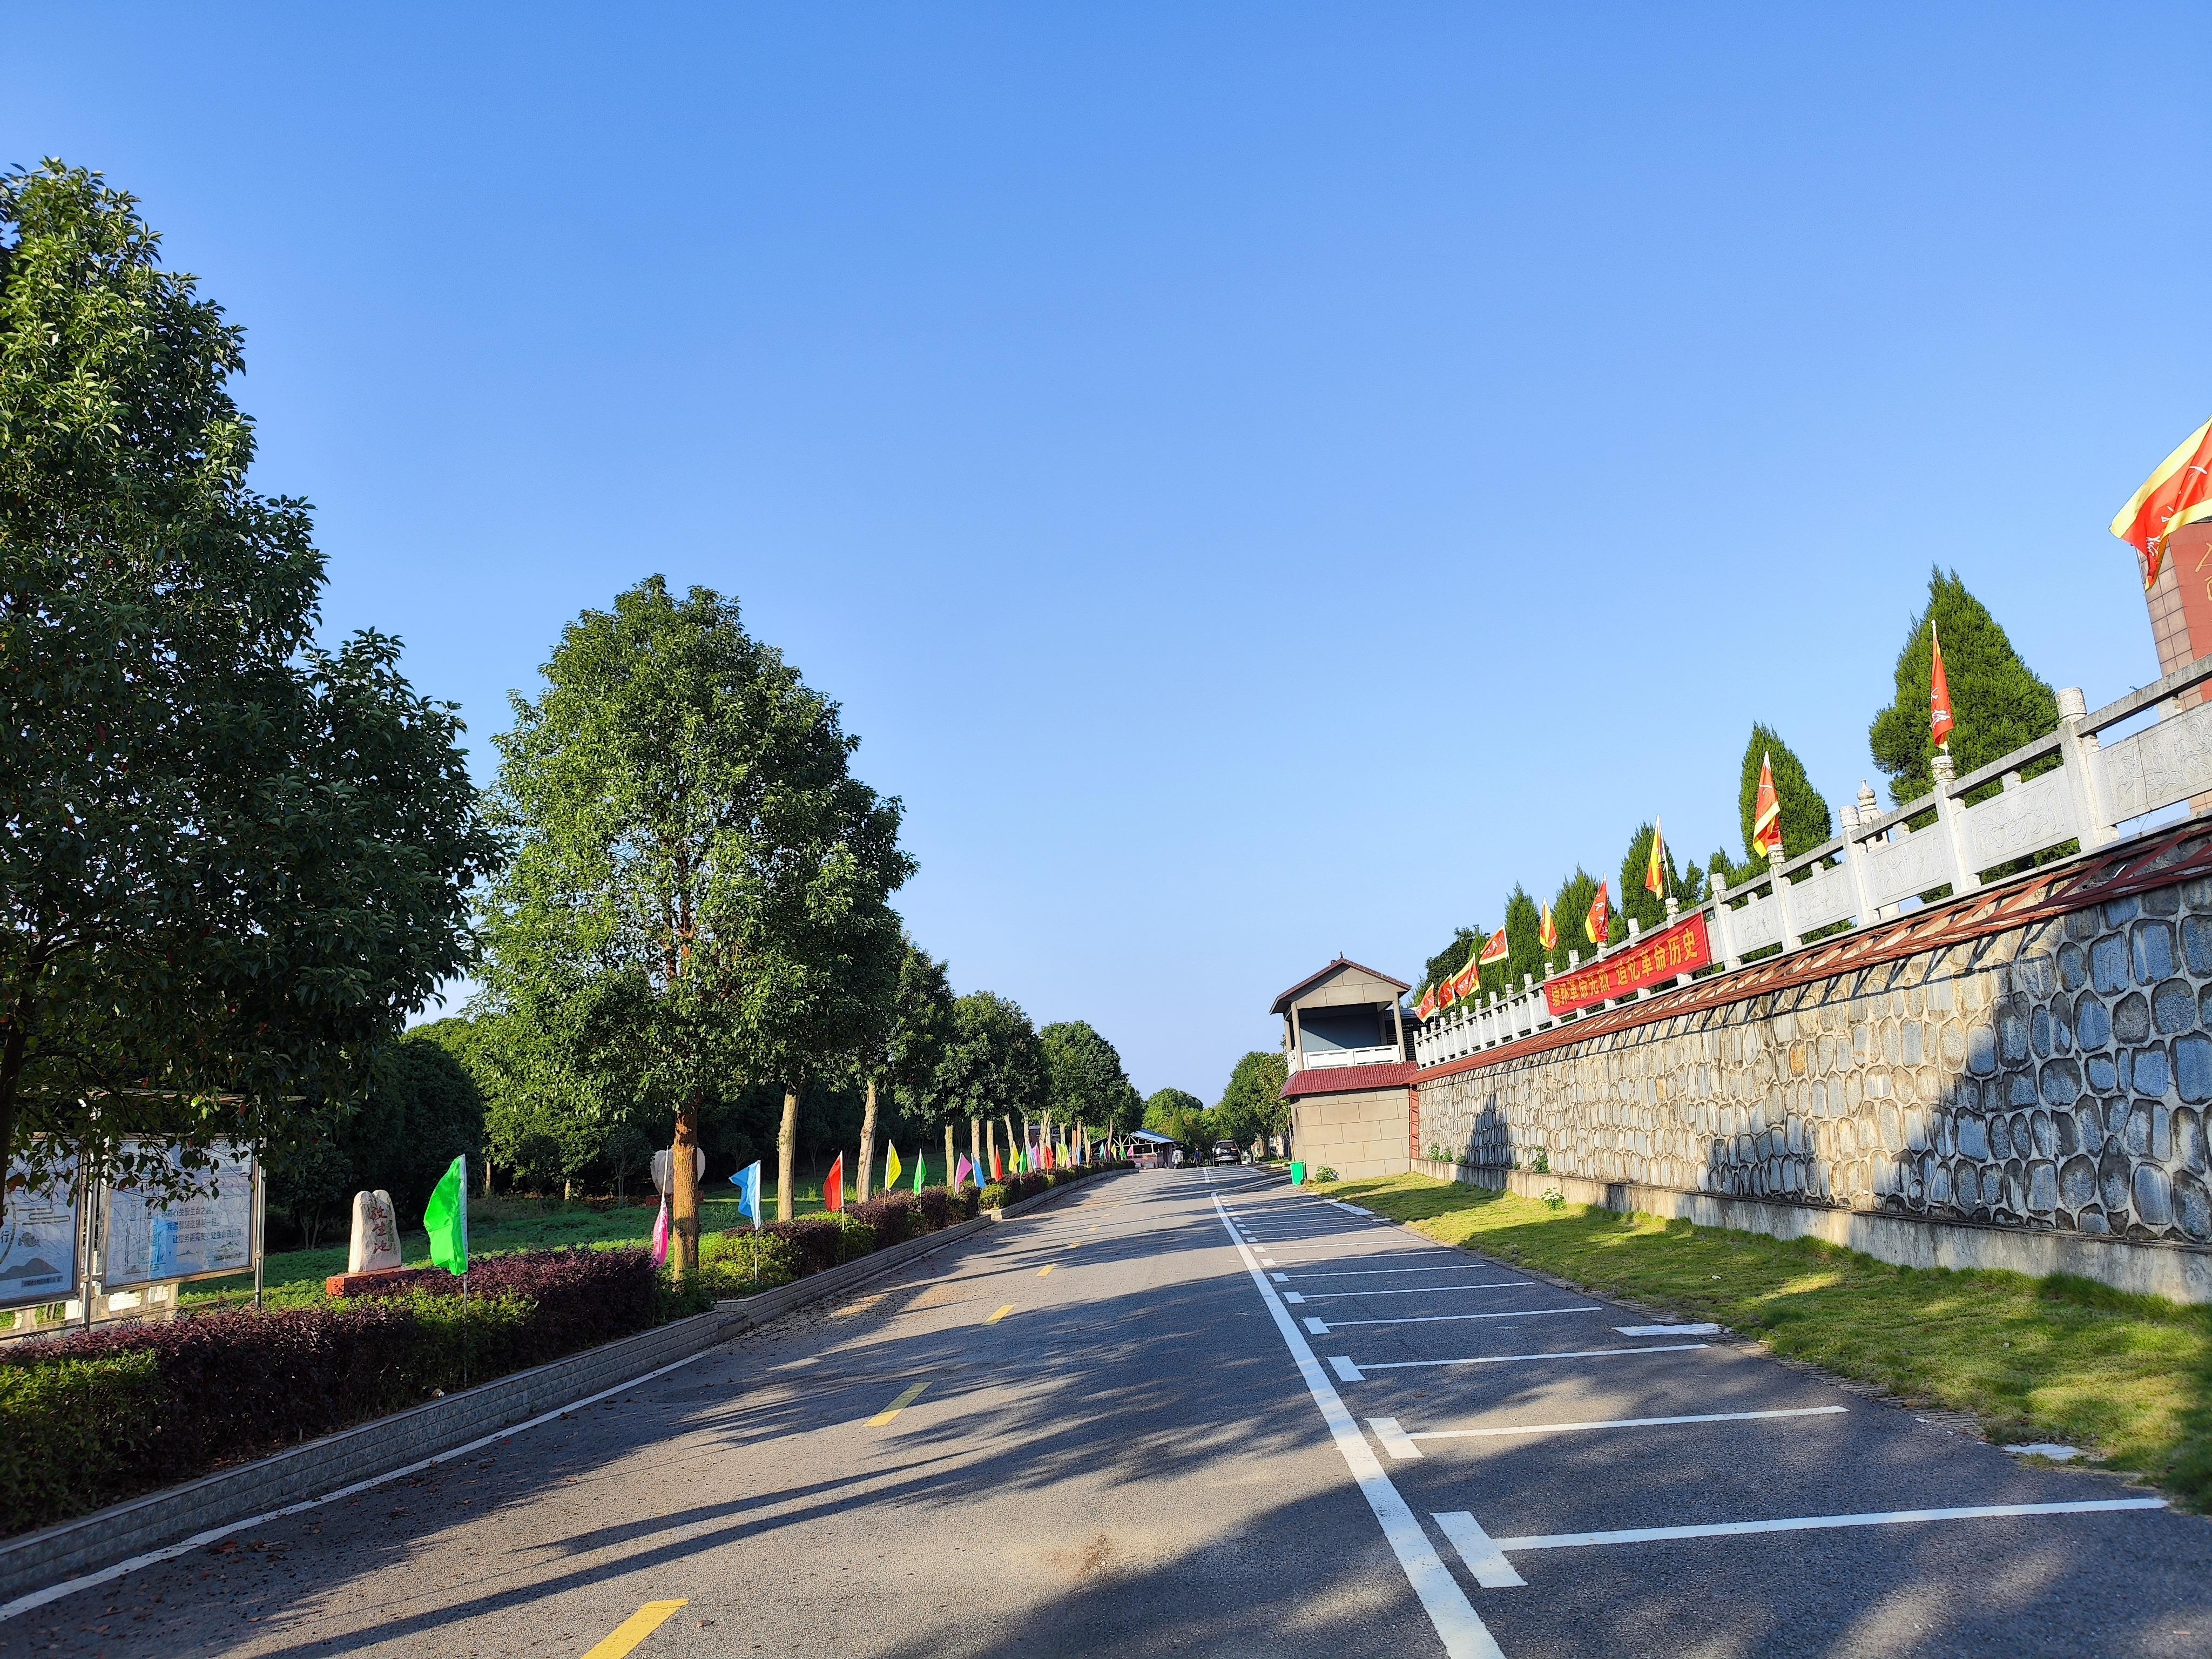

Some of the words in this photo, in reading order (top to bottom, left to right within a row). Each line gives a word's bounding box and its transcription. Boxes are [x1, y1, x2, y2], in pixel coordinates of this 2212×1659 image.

[1614, 927, 1698, 986] 追忆革命历史
[369, 1205, 391, 1254] 放生池
